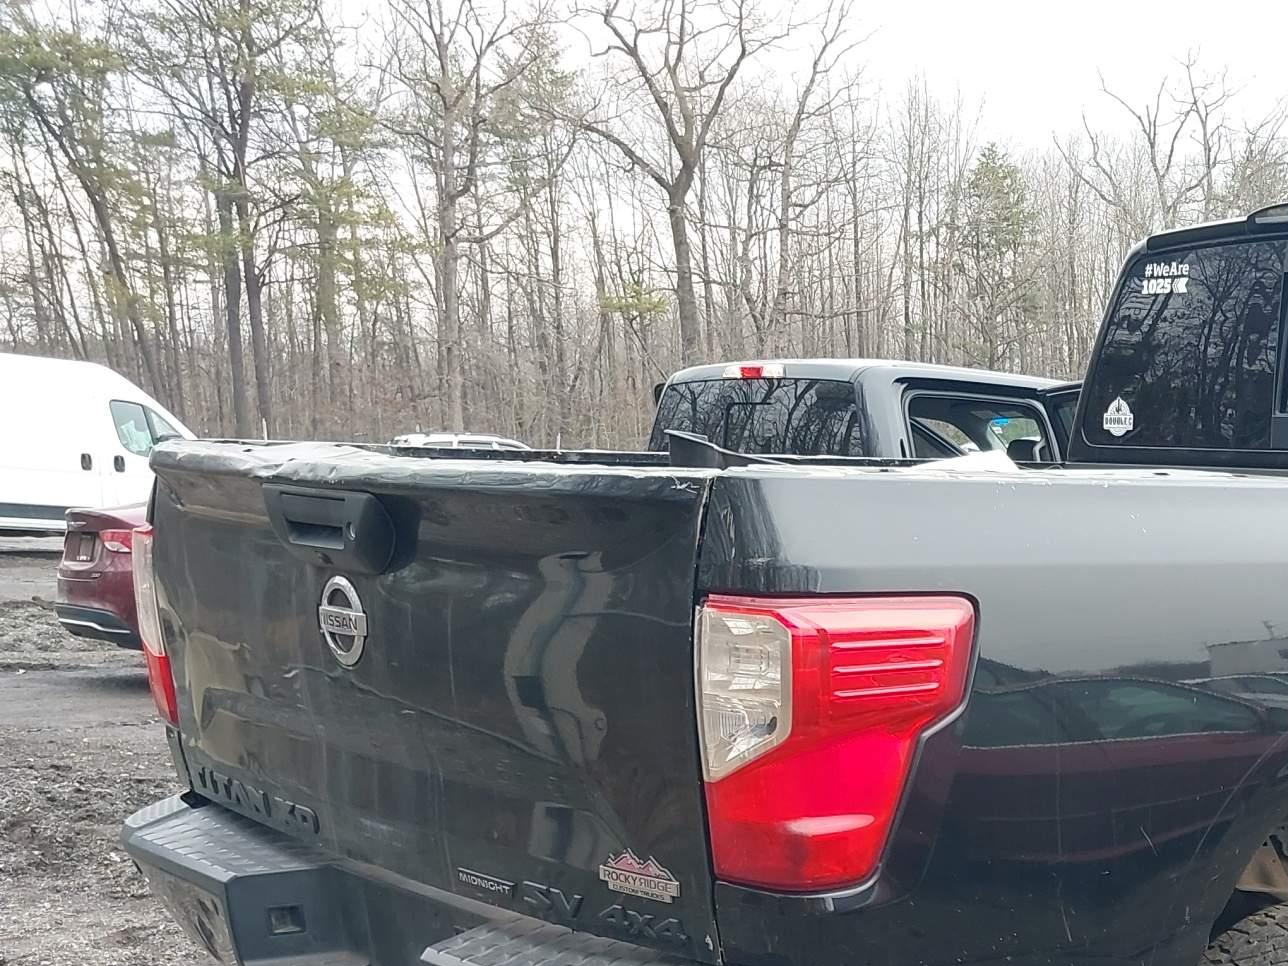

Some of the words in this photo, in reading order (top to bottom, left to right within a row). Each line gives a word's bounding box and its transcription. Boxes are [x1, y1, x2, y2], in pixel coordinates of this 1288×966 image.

[1144, 261, 1190, 278] #WeAre
[1141, 278, 1172, 295] 1025
[1104, 416, 1127, 426] DOUBLE
[320, 612, 358, 631] NISSAN
[198, 766, 273, 818] TITAN
[458, 871, 511, 896] MIDNIGHT
[603, 869, 638, 887] ROCKY
[639, 876, 673, 894] RIDGE
[523, 879, 584, 922] SV
[612, 883, 640, 895] CUSTOM
[640, 889, 665, 901] TRUCKS
